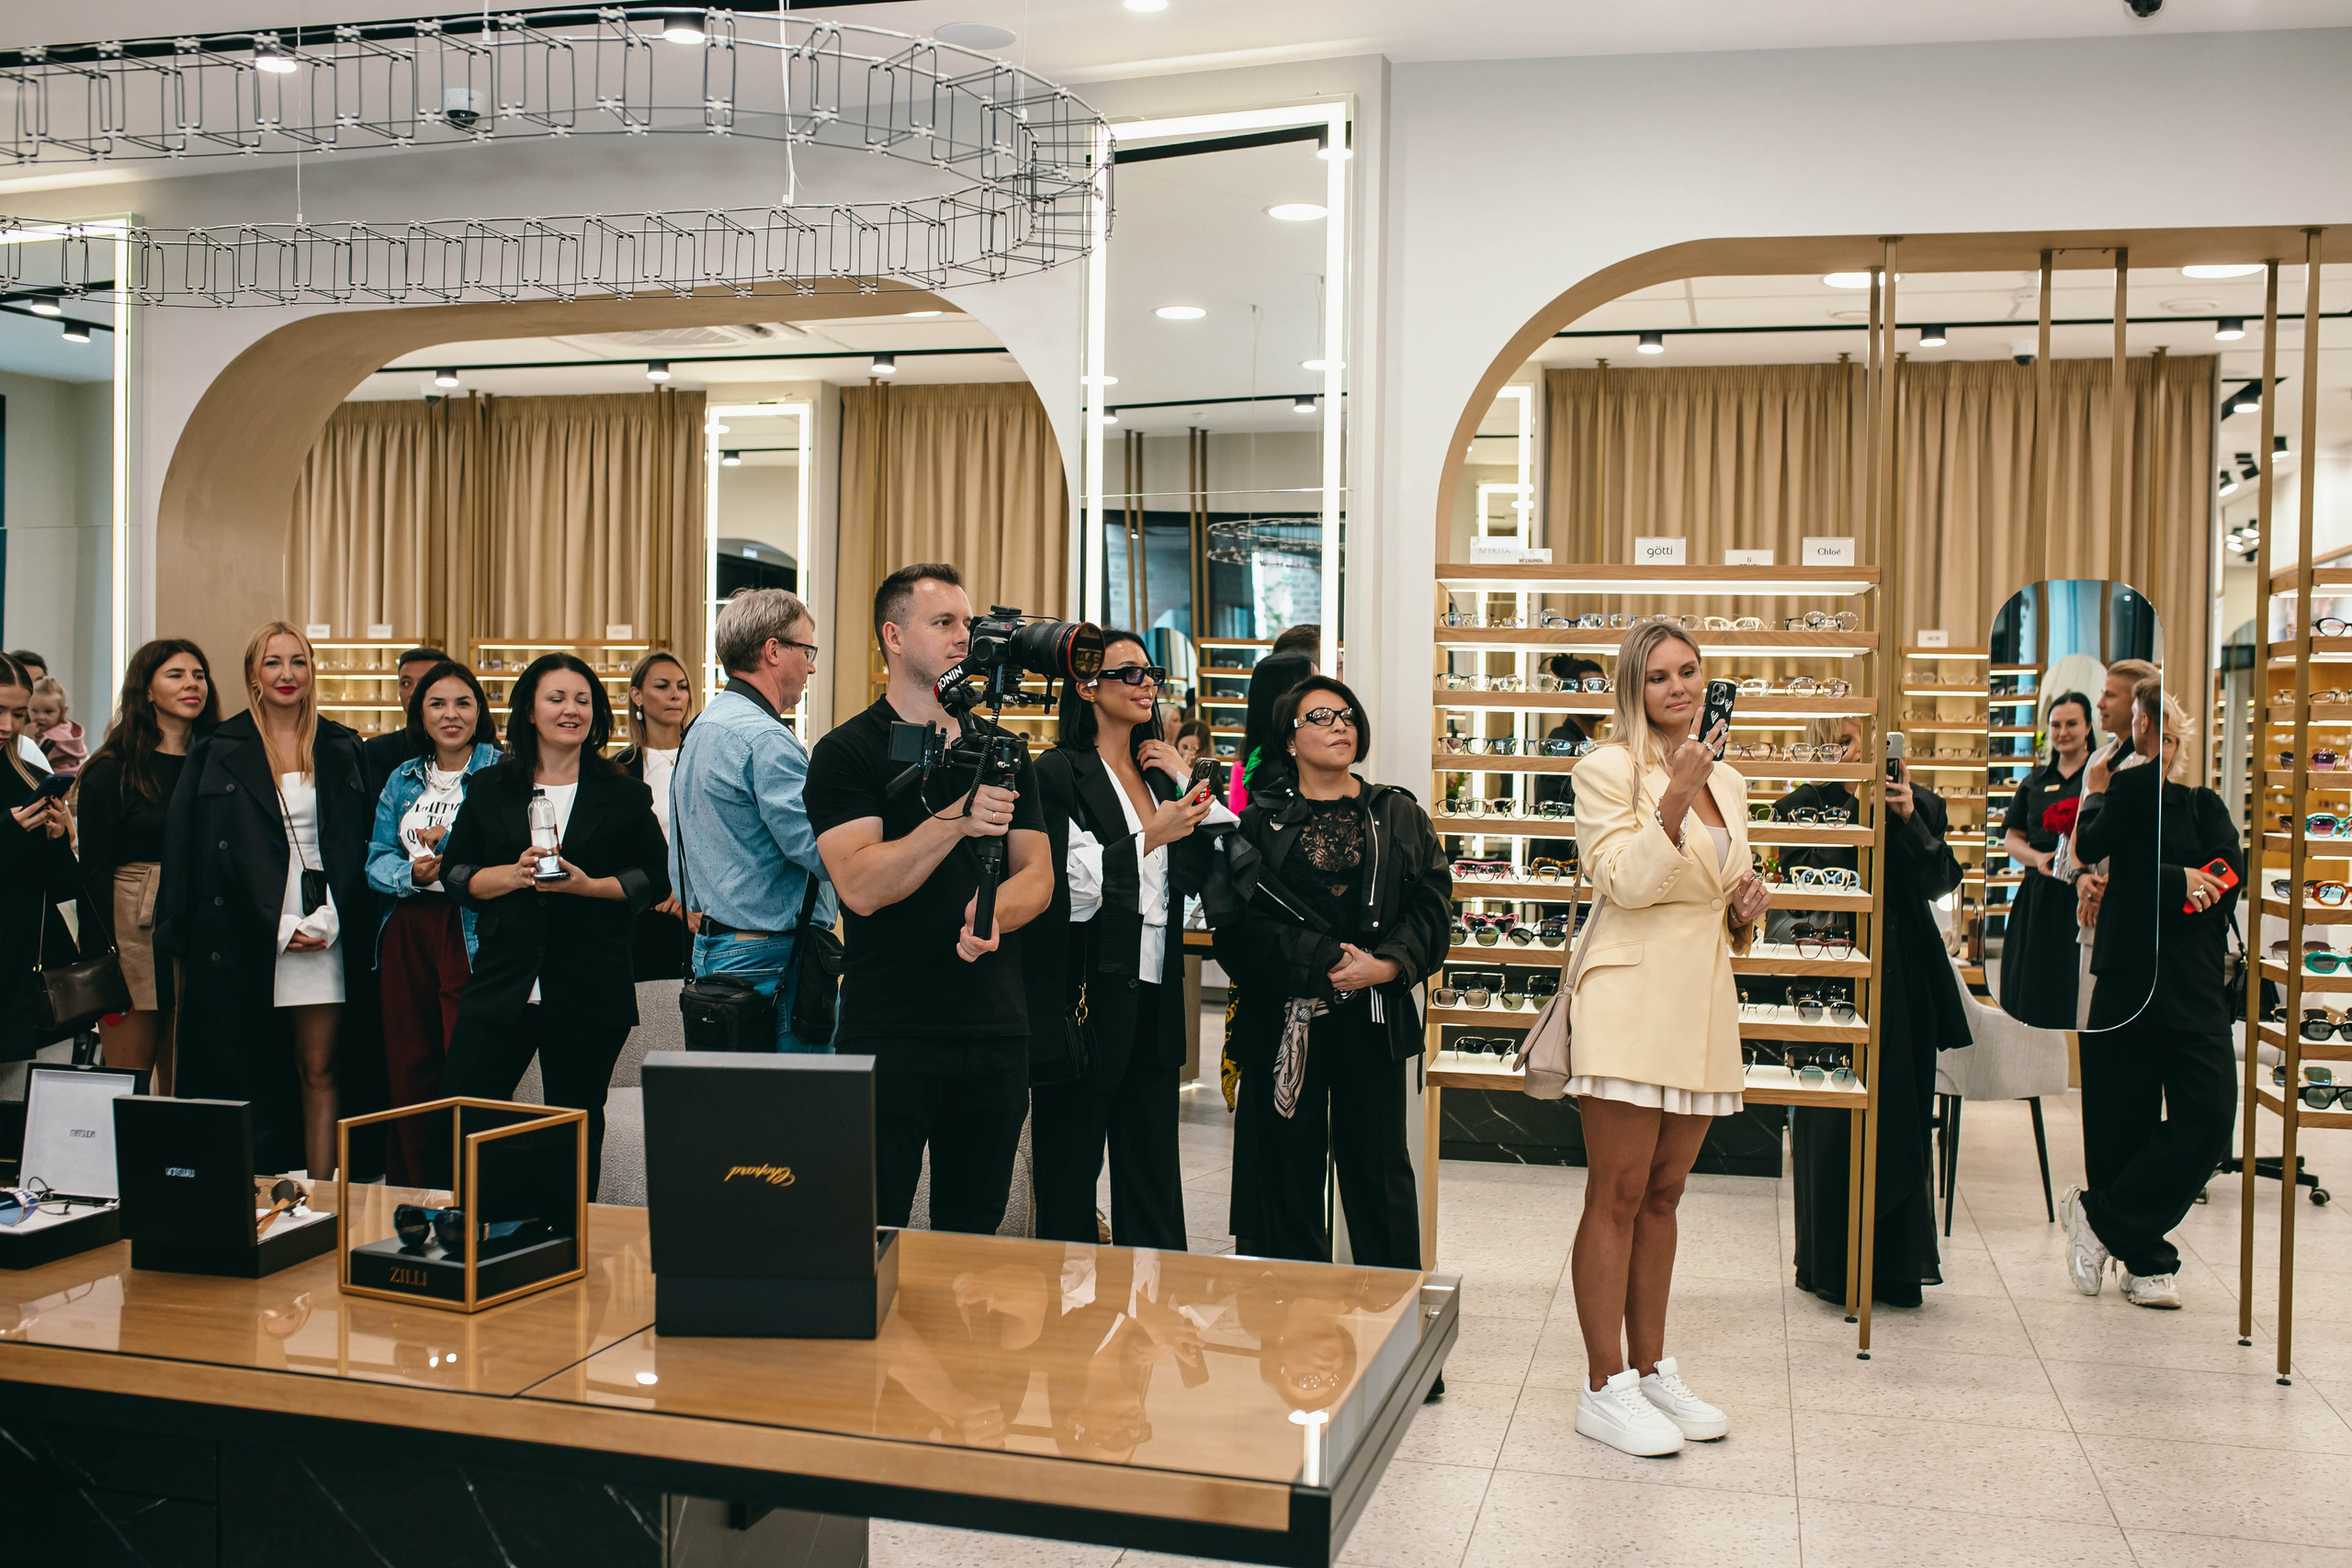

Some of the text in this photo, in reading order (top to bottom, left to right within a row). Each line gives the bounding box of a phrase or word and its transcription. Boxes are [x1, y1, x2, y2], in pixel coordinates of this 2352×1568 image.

[1646, 546, 1673, 558] götti
[1817, 547, 1841, 556] Chloé
[937, 664, 964, 693] RONIN
[723, 1163, 796, 1187] Chopard
[390, 1267, 427, 1287] ZILLI
